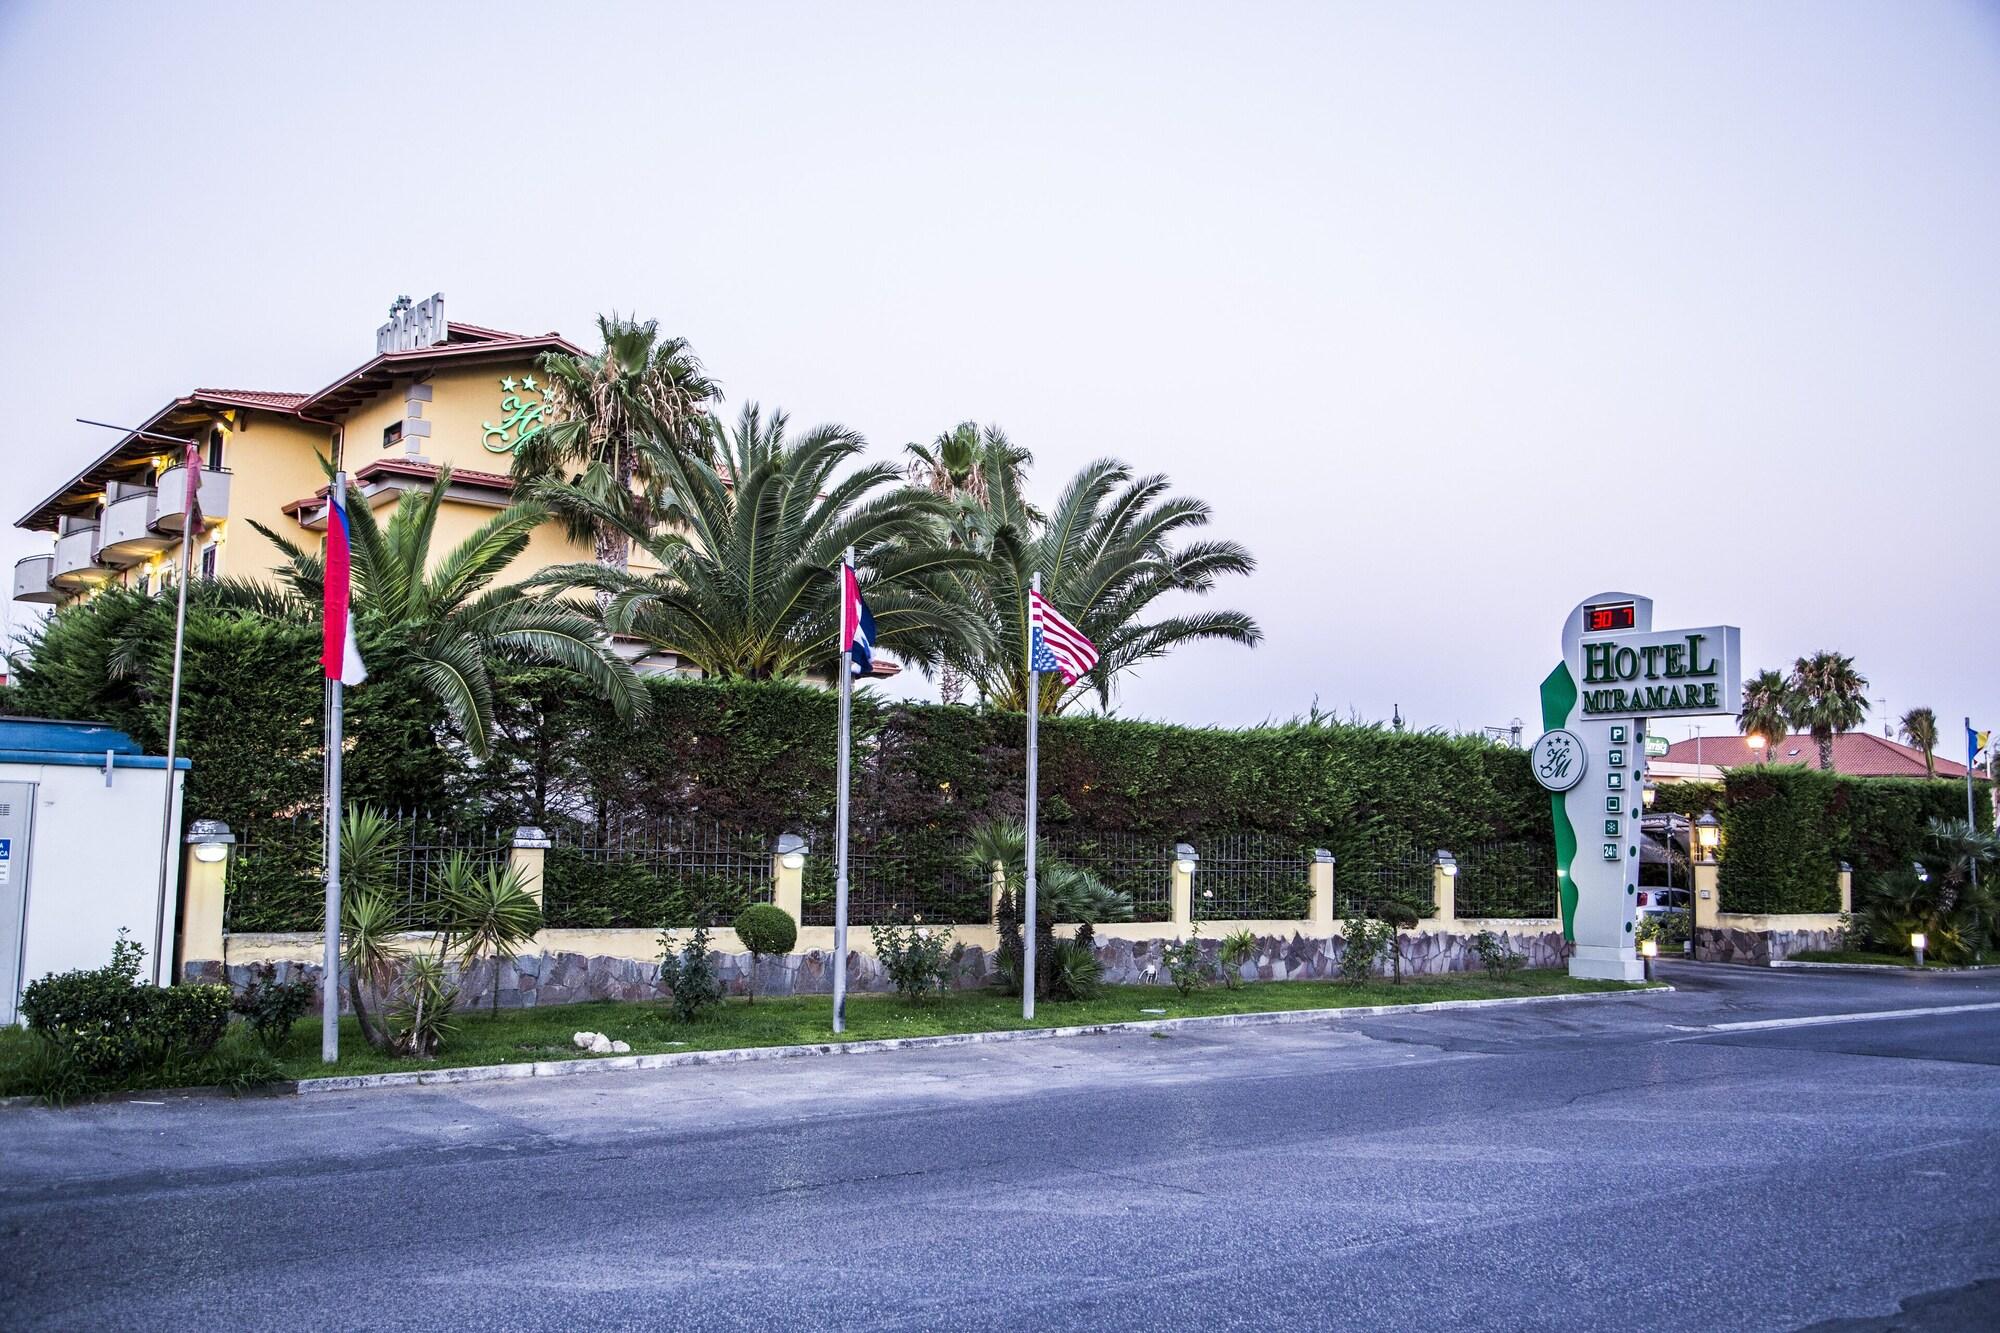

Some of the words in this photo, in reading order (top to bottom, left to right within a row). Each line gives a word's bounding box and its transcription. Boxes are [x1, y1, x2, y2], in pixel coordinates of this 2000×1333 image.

[1592, 610, 1612, 629] 30
[1623, 608, 1633, 625] 7
[1582, 634, 1718, 683] HOTEL
[1582, 682, 1719, 715] MIRAMARE
[1613, 729, 1622, 739] P
